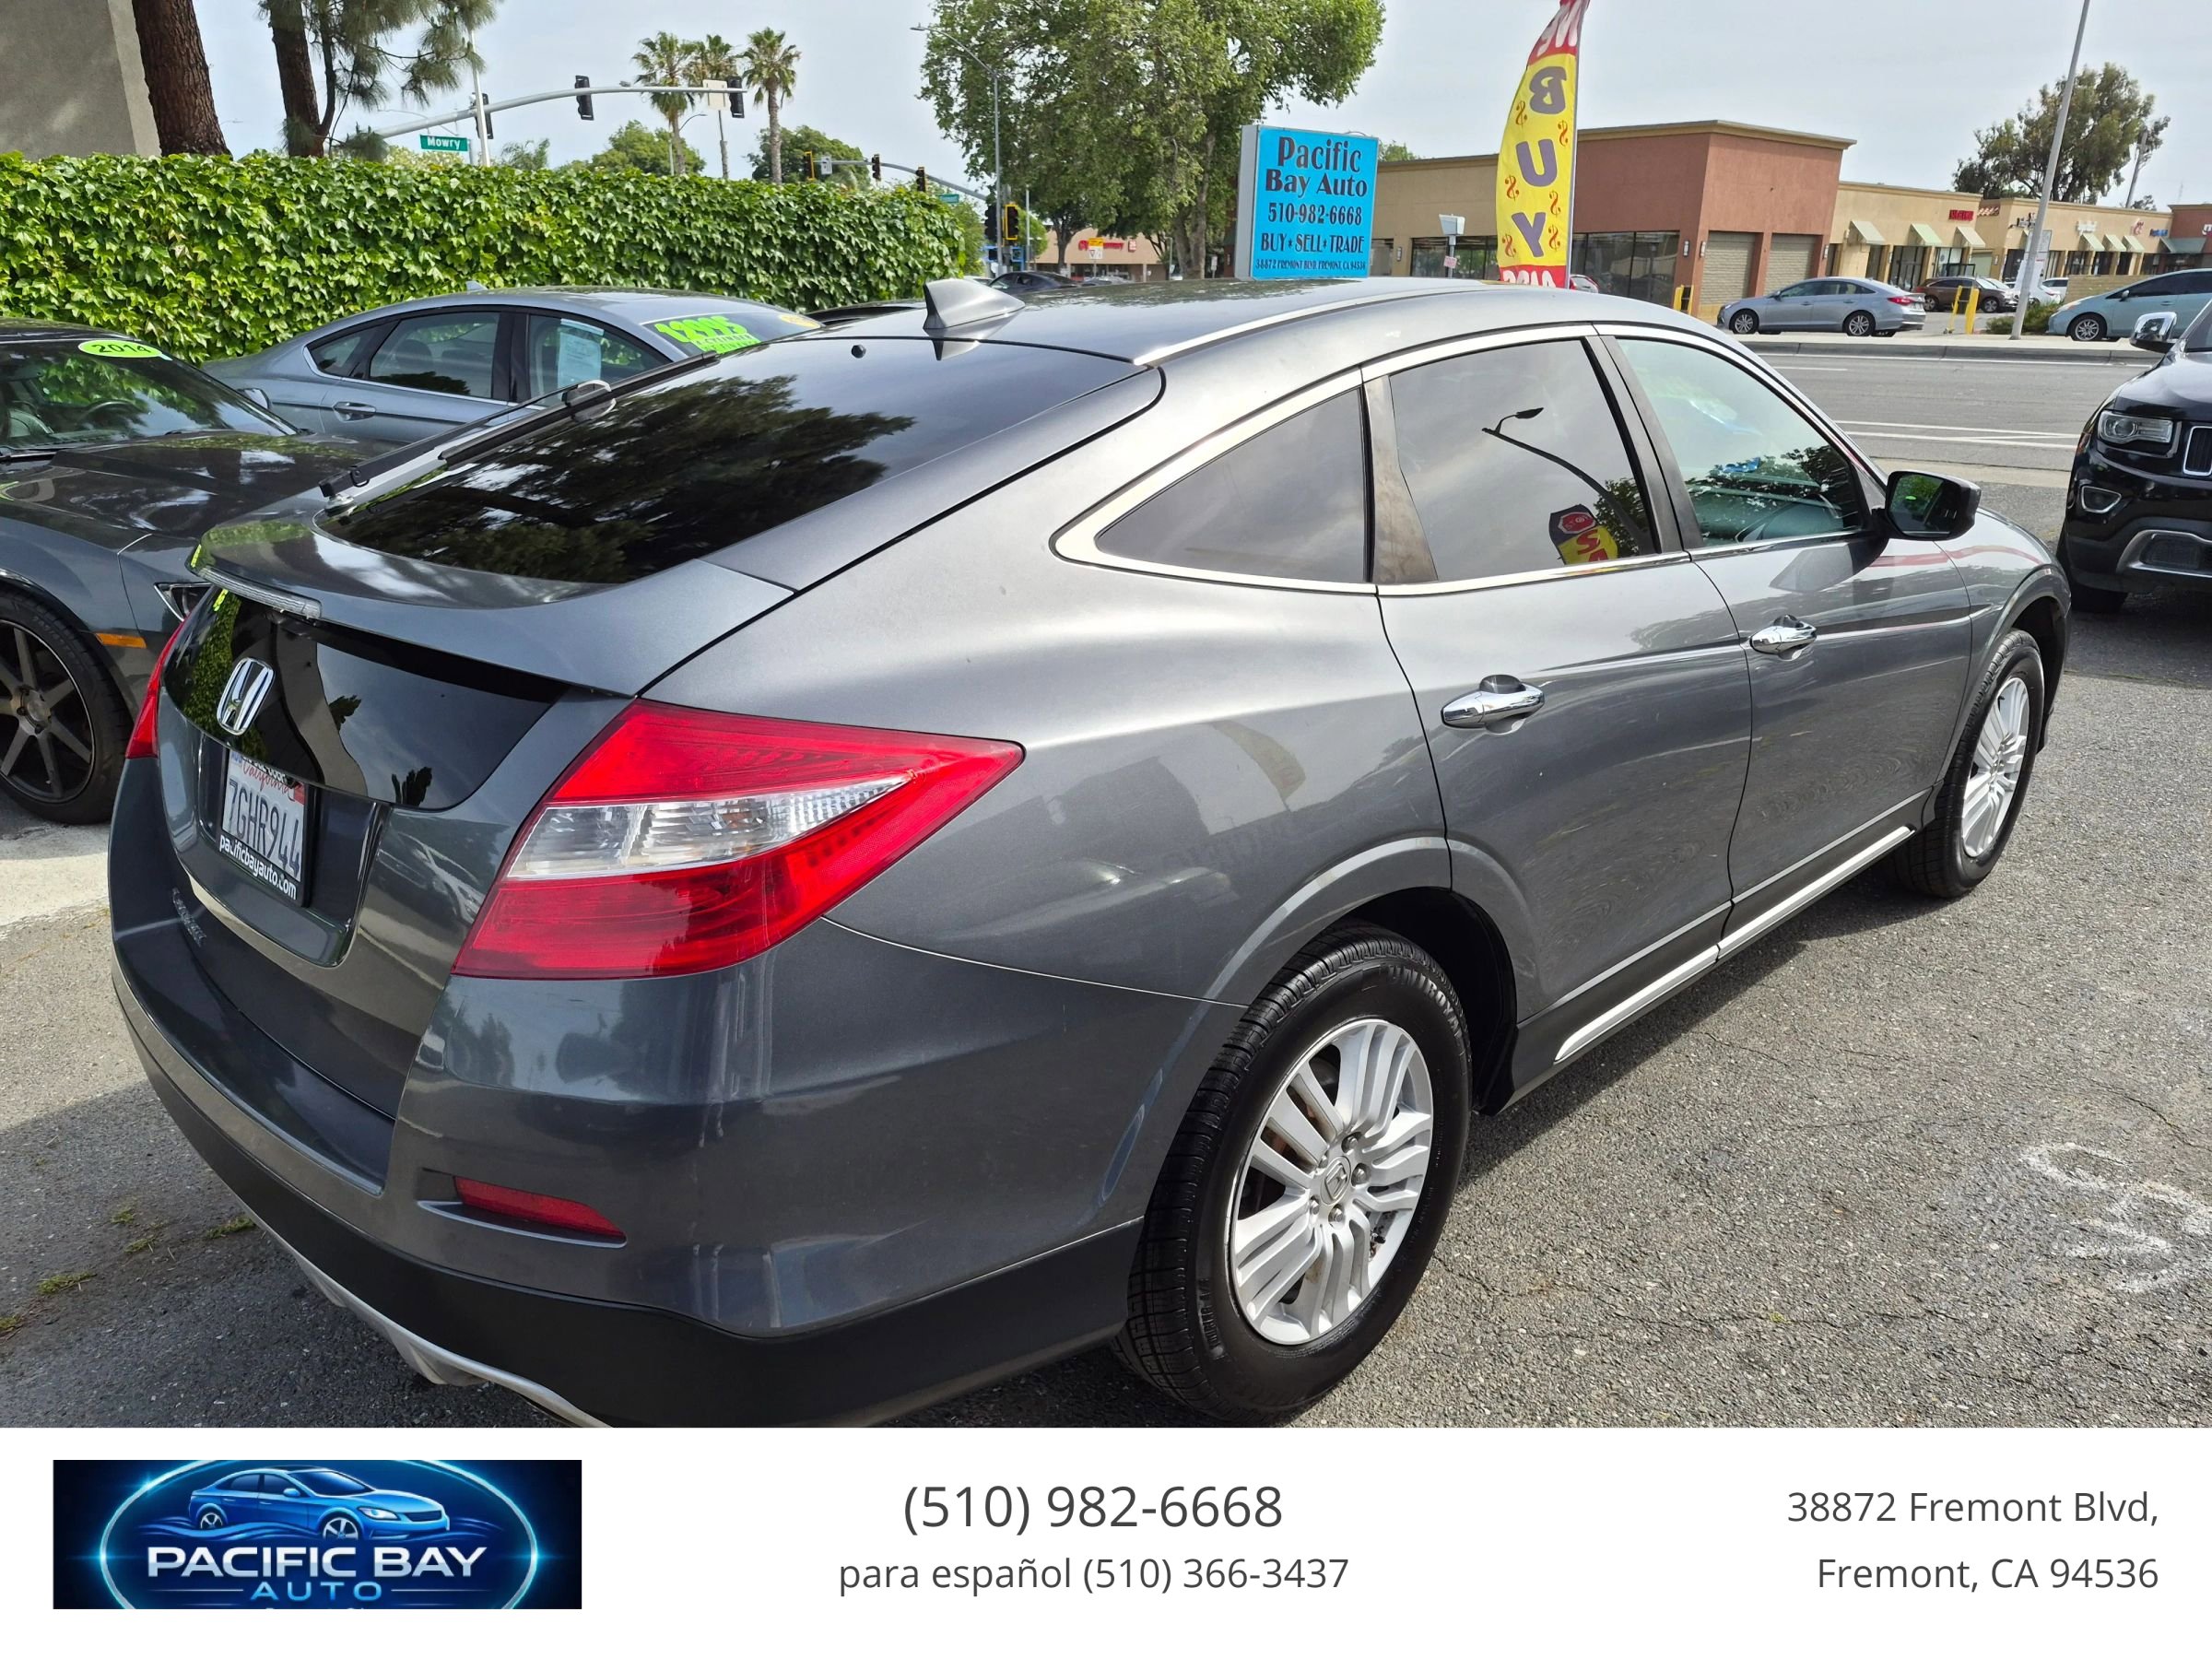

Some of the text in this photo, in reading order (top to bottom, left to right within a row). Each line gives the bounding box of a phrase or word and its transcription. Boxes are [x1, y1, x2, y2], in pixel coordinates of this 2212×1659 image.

[427, 136, 461, 150] Mowry
[1277, 136, 1361, 173] Pacific
[1265, 169, 1368, 198] Bay Auto
[1267, 202, 1362, 226] 510-982-6668
[1261, 232, 1365, 253] BUY SELL TRADE
[91, 344, 152, 354] 2014
[229, 778, 301, 877] 7GHR944
